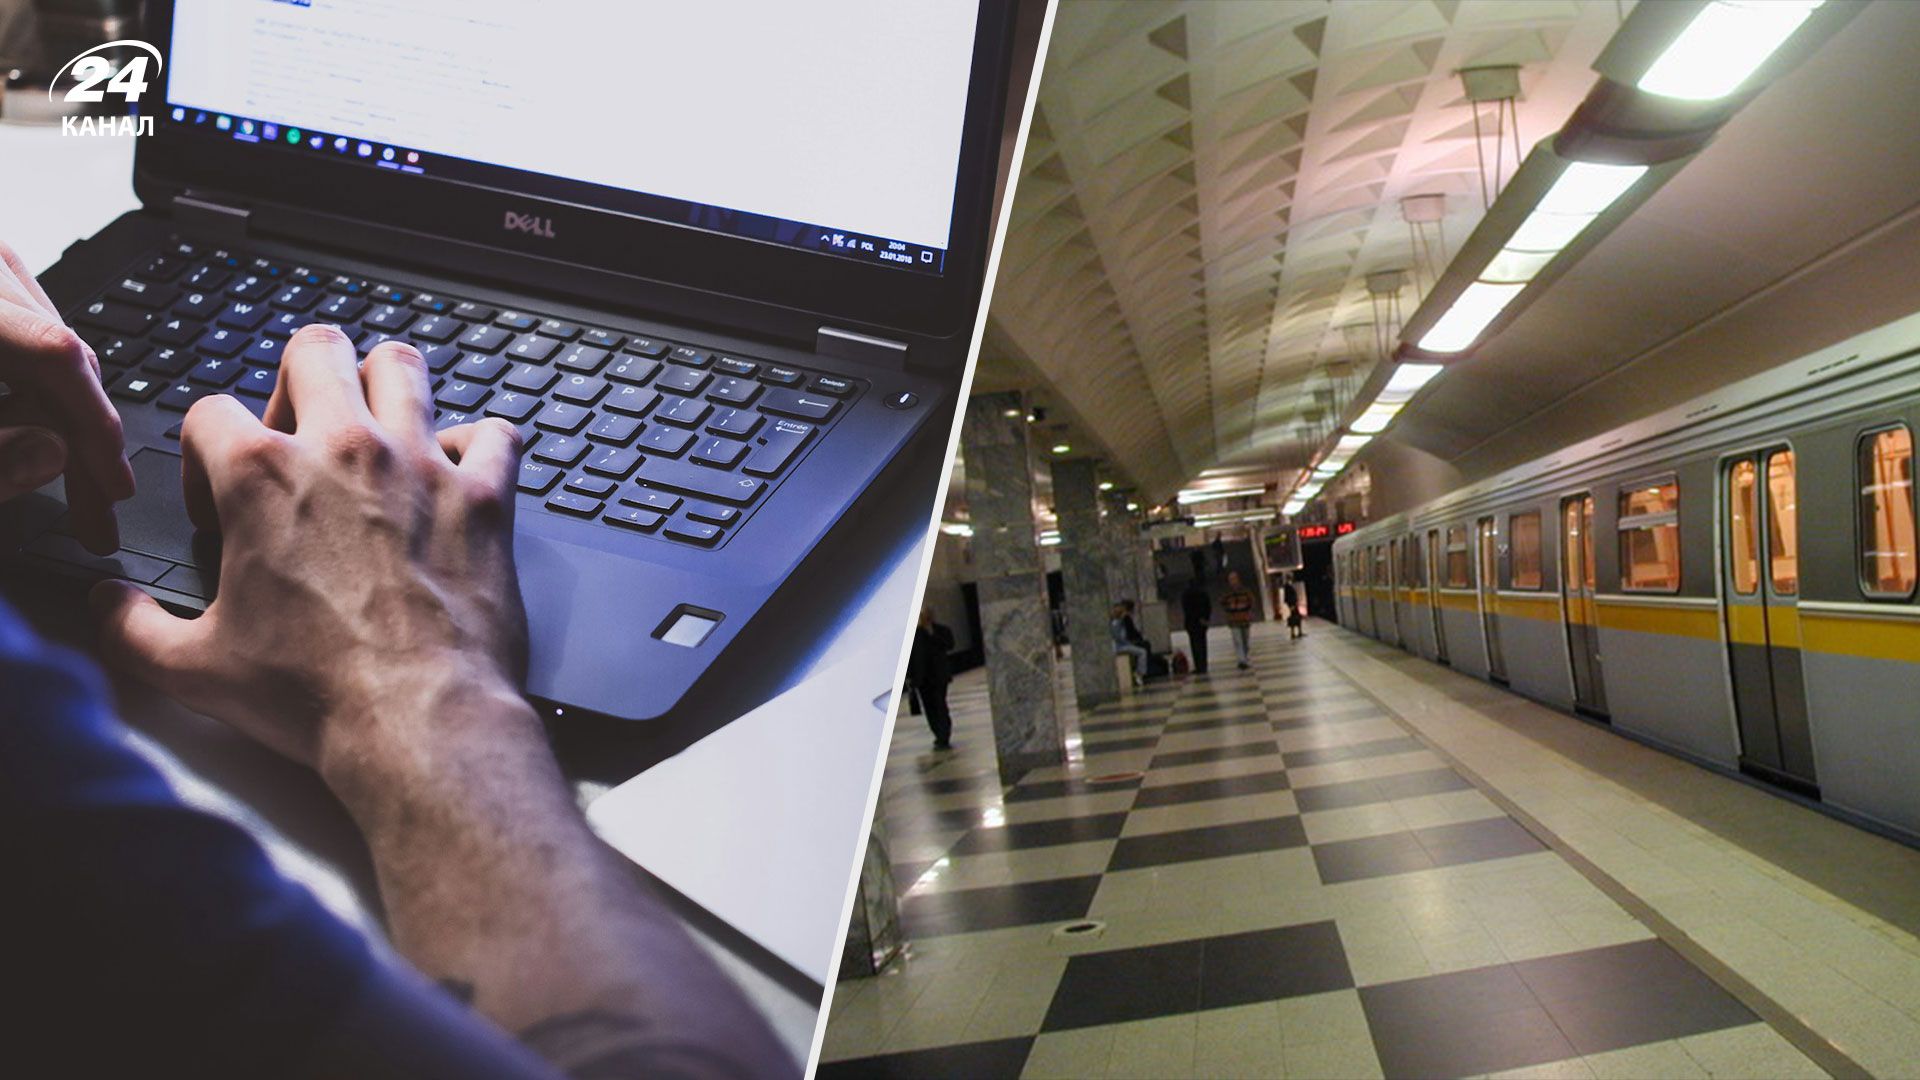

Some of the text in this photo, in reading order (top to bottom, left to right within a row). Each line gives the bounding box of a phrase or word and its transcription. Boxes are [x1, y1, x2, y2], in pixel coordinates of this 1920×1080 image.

[503, 210, 556, 239] DELL
[861, 242, 874, 251] POL
[234, 302, 253, 314] W
[167, 320, 180, 330] A
[590, 329, 607, 338] F10
[260, 339, 274, 349] D
[633, 338, 650, 347] F11
[425, 345, 438, 353] Y
[677, 347, 695, 356] F12
[472, 355, 487, 364] U
[206, 359, 222, 370] X
[254, 370, 268, 379] C
[819, 376, 846, 388] Delete
[454, 383, 467, 391] J
[621, 387, 635, 395] P
[502, 393, 518, 402] K
[554, 404, 564, 413] L
[448, 412, 466, 423] M
[777, 419, 808, 430] Entrée
[524, 463, 543, 473] Ctrl
